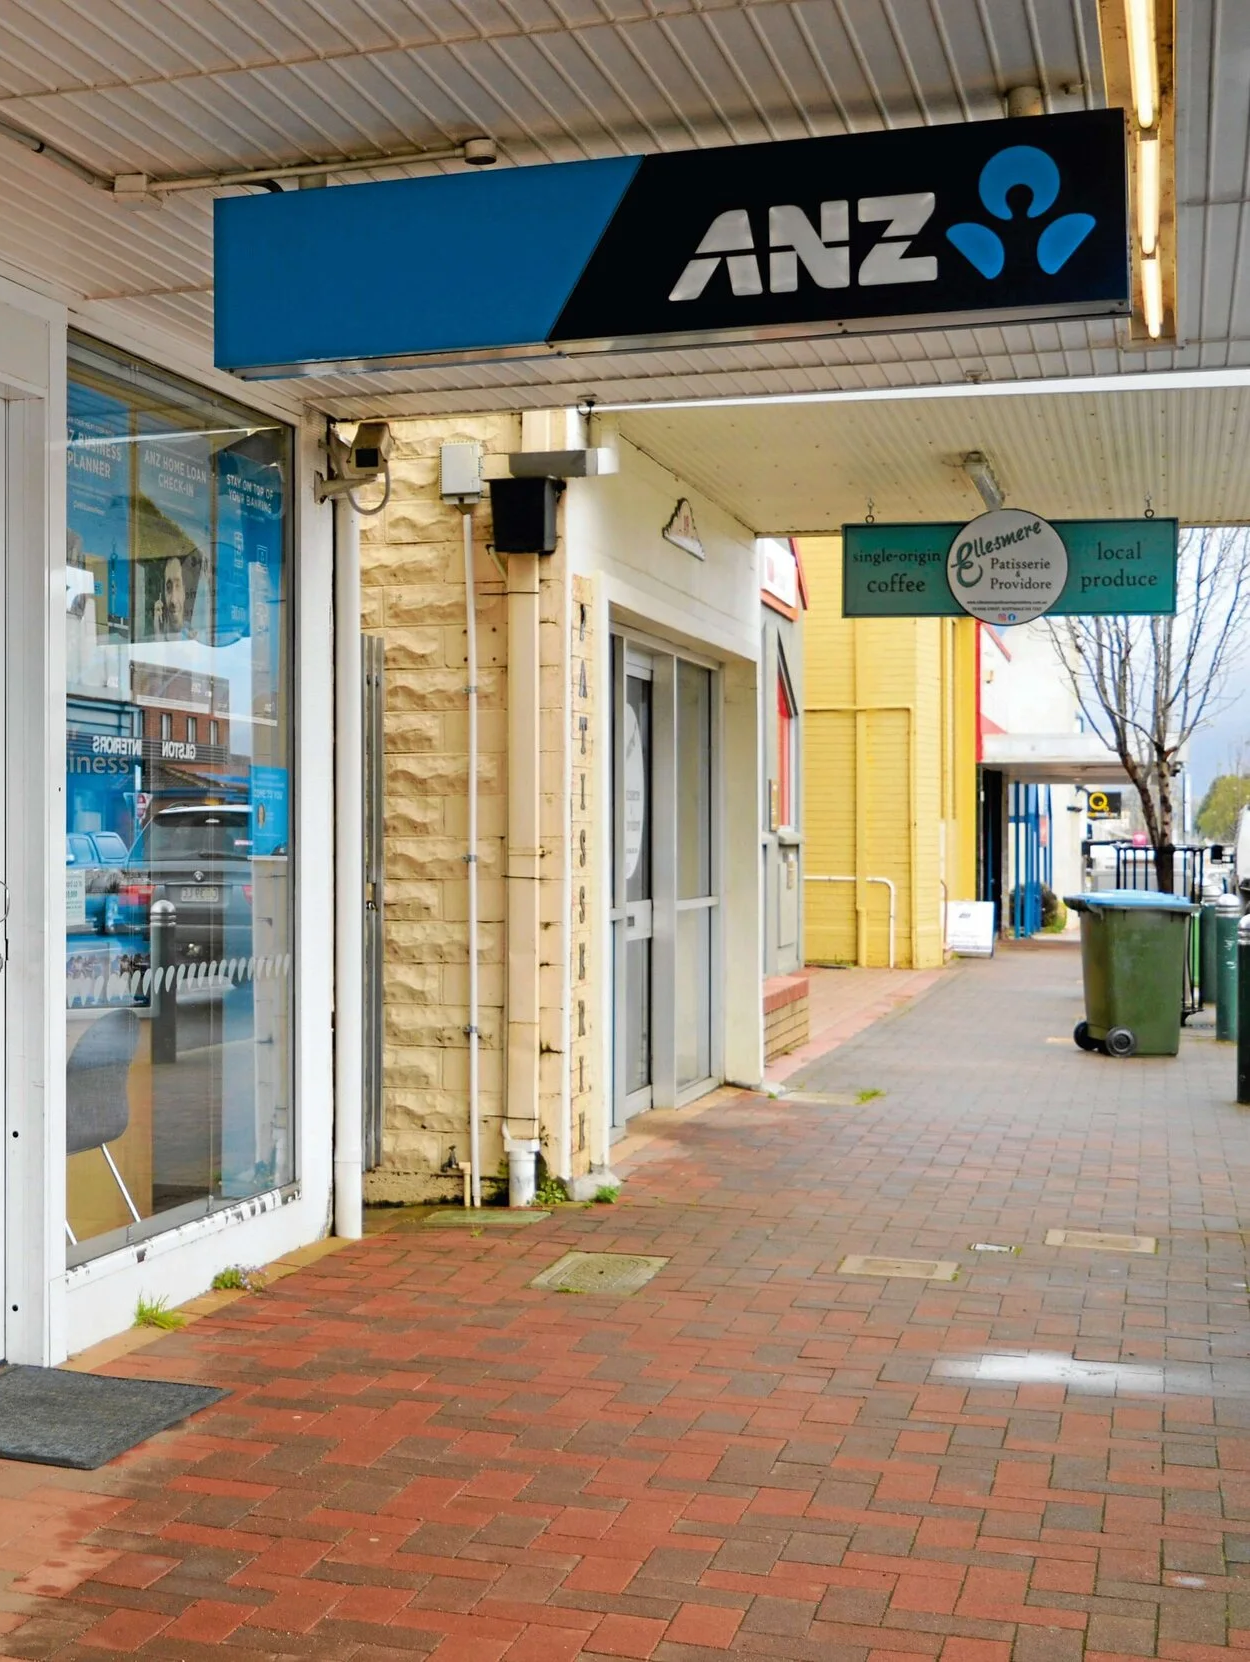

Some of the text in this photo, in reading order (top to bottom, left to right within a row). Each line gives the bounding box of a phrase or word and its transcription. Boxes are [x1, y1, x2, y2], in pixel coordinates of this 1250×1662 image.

[667, 191, 940, 303] ANZ
[67, 450, 111, 480] PLANNER
[144, 450, 161, 468] ANZ
[163, 457, 185, 477] HOME
[186, 464, 207, 484] LOAN
[158, 473, 195, 498] CHECK-IN
[852, 548, 942, 567] single-origin
[950, 521, 1042, 588] Ellesmere
[1097, 541, 1142, 560] local
[990, 557, 1051, 570] Patisserie
[867, 573, 926, 593] coffee
[990, 577, 1052, 590] Providore
[1080, 568, 1158, 593] produce
[67, 751, 130, 775] iness
